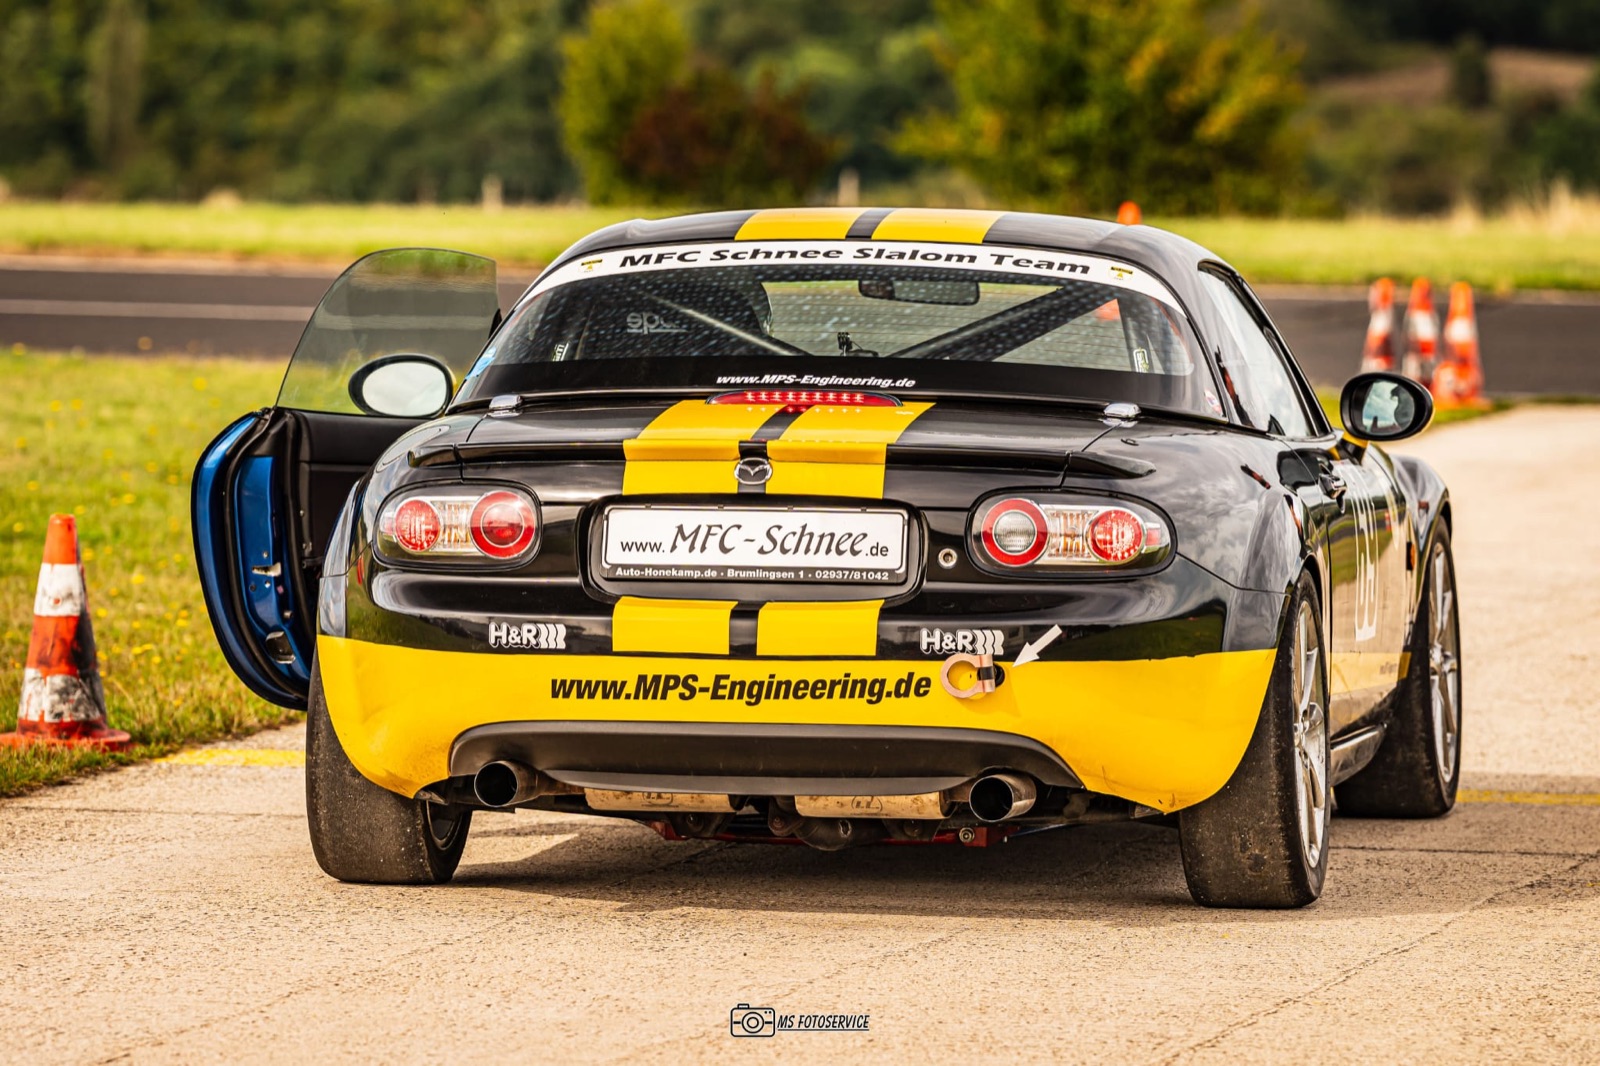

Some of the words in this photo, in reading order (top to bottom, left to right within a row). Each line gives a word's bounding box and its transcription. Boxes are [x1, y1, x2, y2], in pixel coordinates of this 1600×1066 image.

[619, 251, 701, 268] MFC
[709, 248, 843, 262] Schnee
[852, 247, 978, 264] Slalom
[989, 253, 1090, 275] Team
[716, 374, 916, 388] www.MPS-Engineering.de
[615, 567, 718, 579] Auto-Honekamp.de
[727, 568, 795, 580] Brumlingsen
[798, 570, 804, 579] 1
[815, 570, 889, 581] 02937/81042
[489, 621, 541, 649] H&R
[920, 627, 977, 655] H&R
[550, 672, 932, 707] www.MPS-Engineering.de
